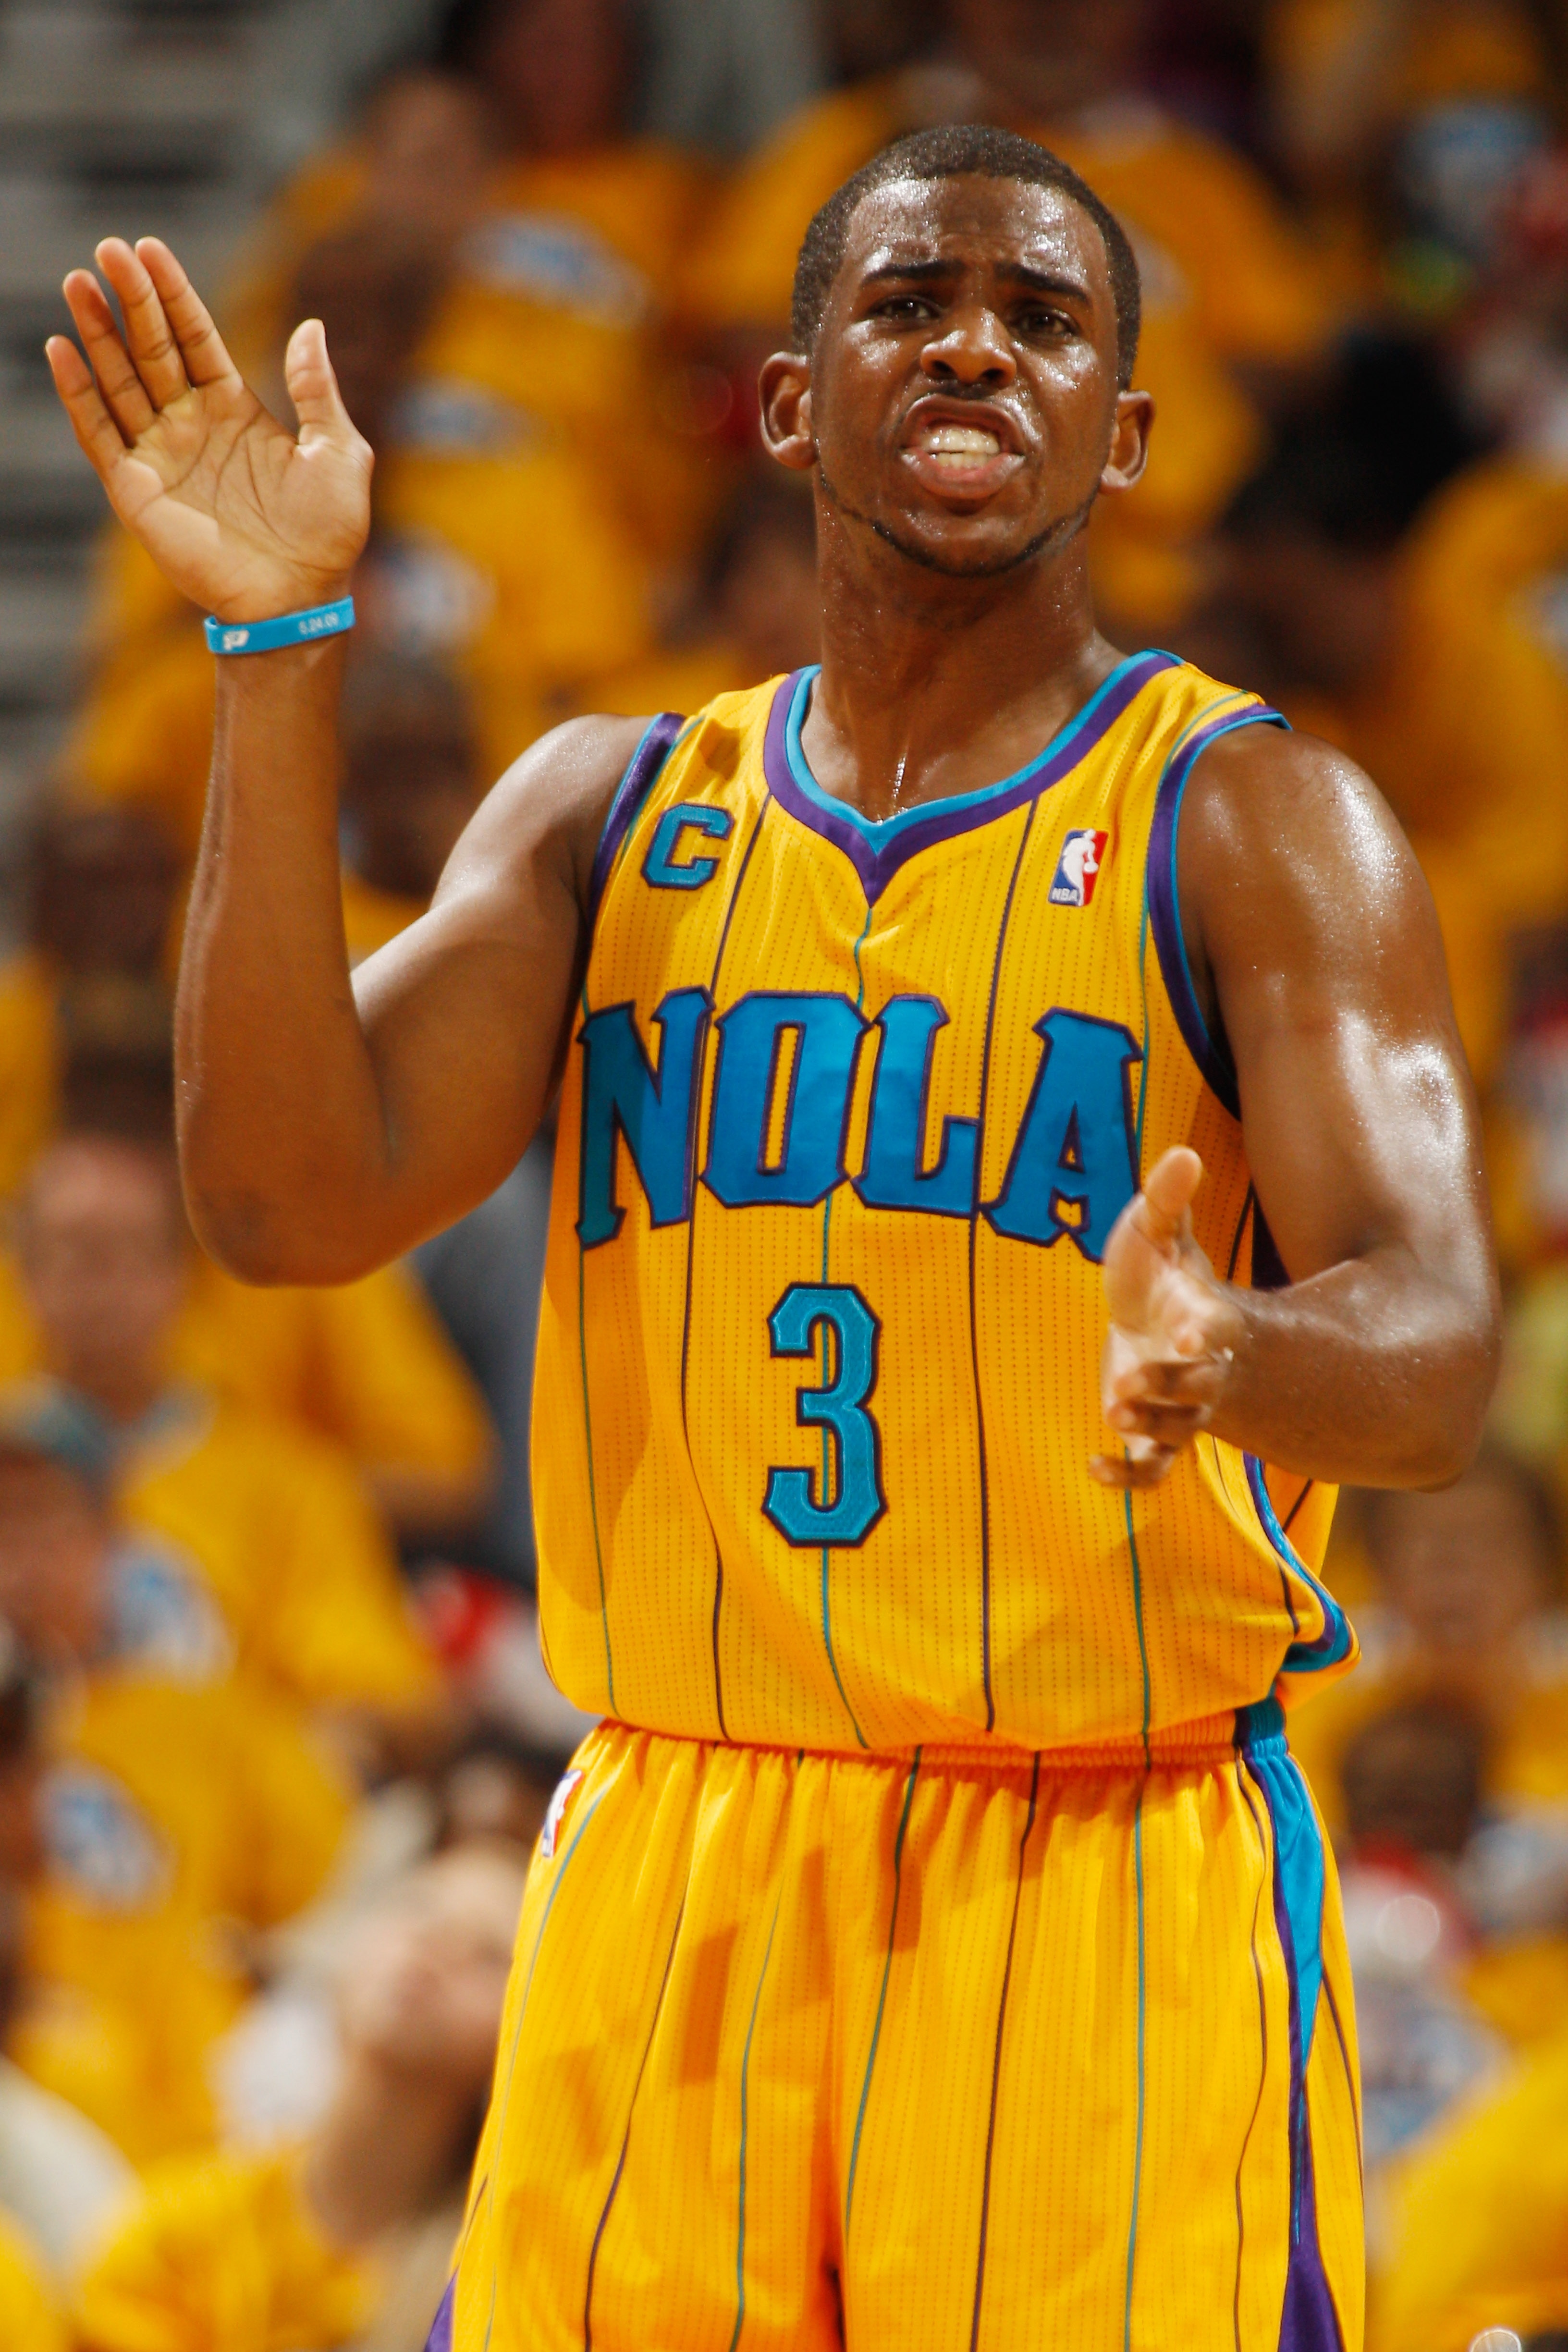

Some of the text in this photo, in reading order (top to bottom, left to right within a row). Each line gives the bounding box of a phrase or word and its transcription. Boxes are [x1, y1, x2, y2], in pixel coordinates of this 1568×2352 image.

[641, 803, 735, 890] C
[1052, 888, 1078, 902] NBA
[577, 986, 1143, 1264] NOLA
[762, 1282, 889, 1547] 3
